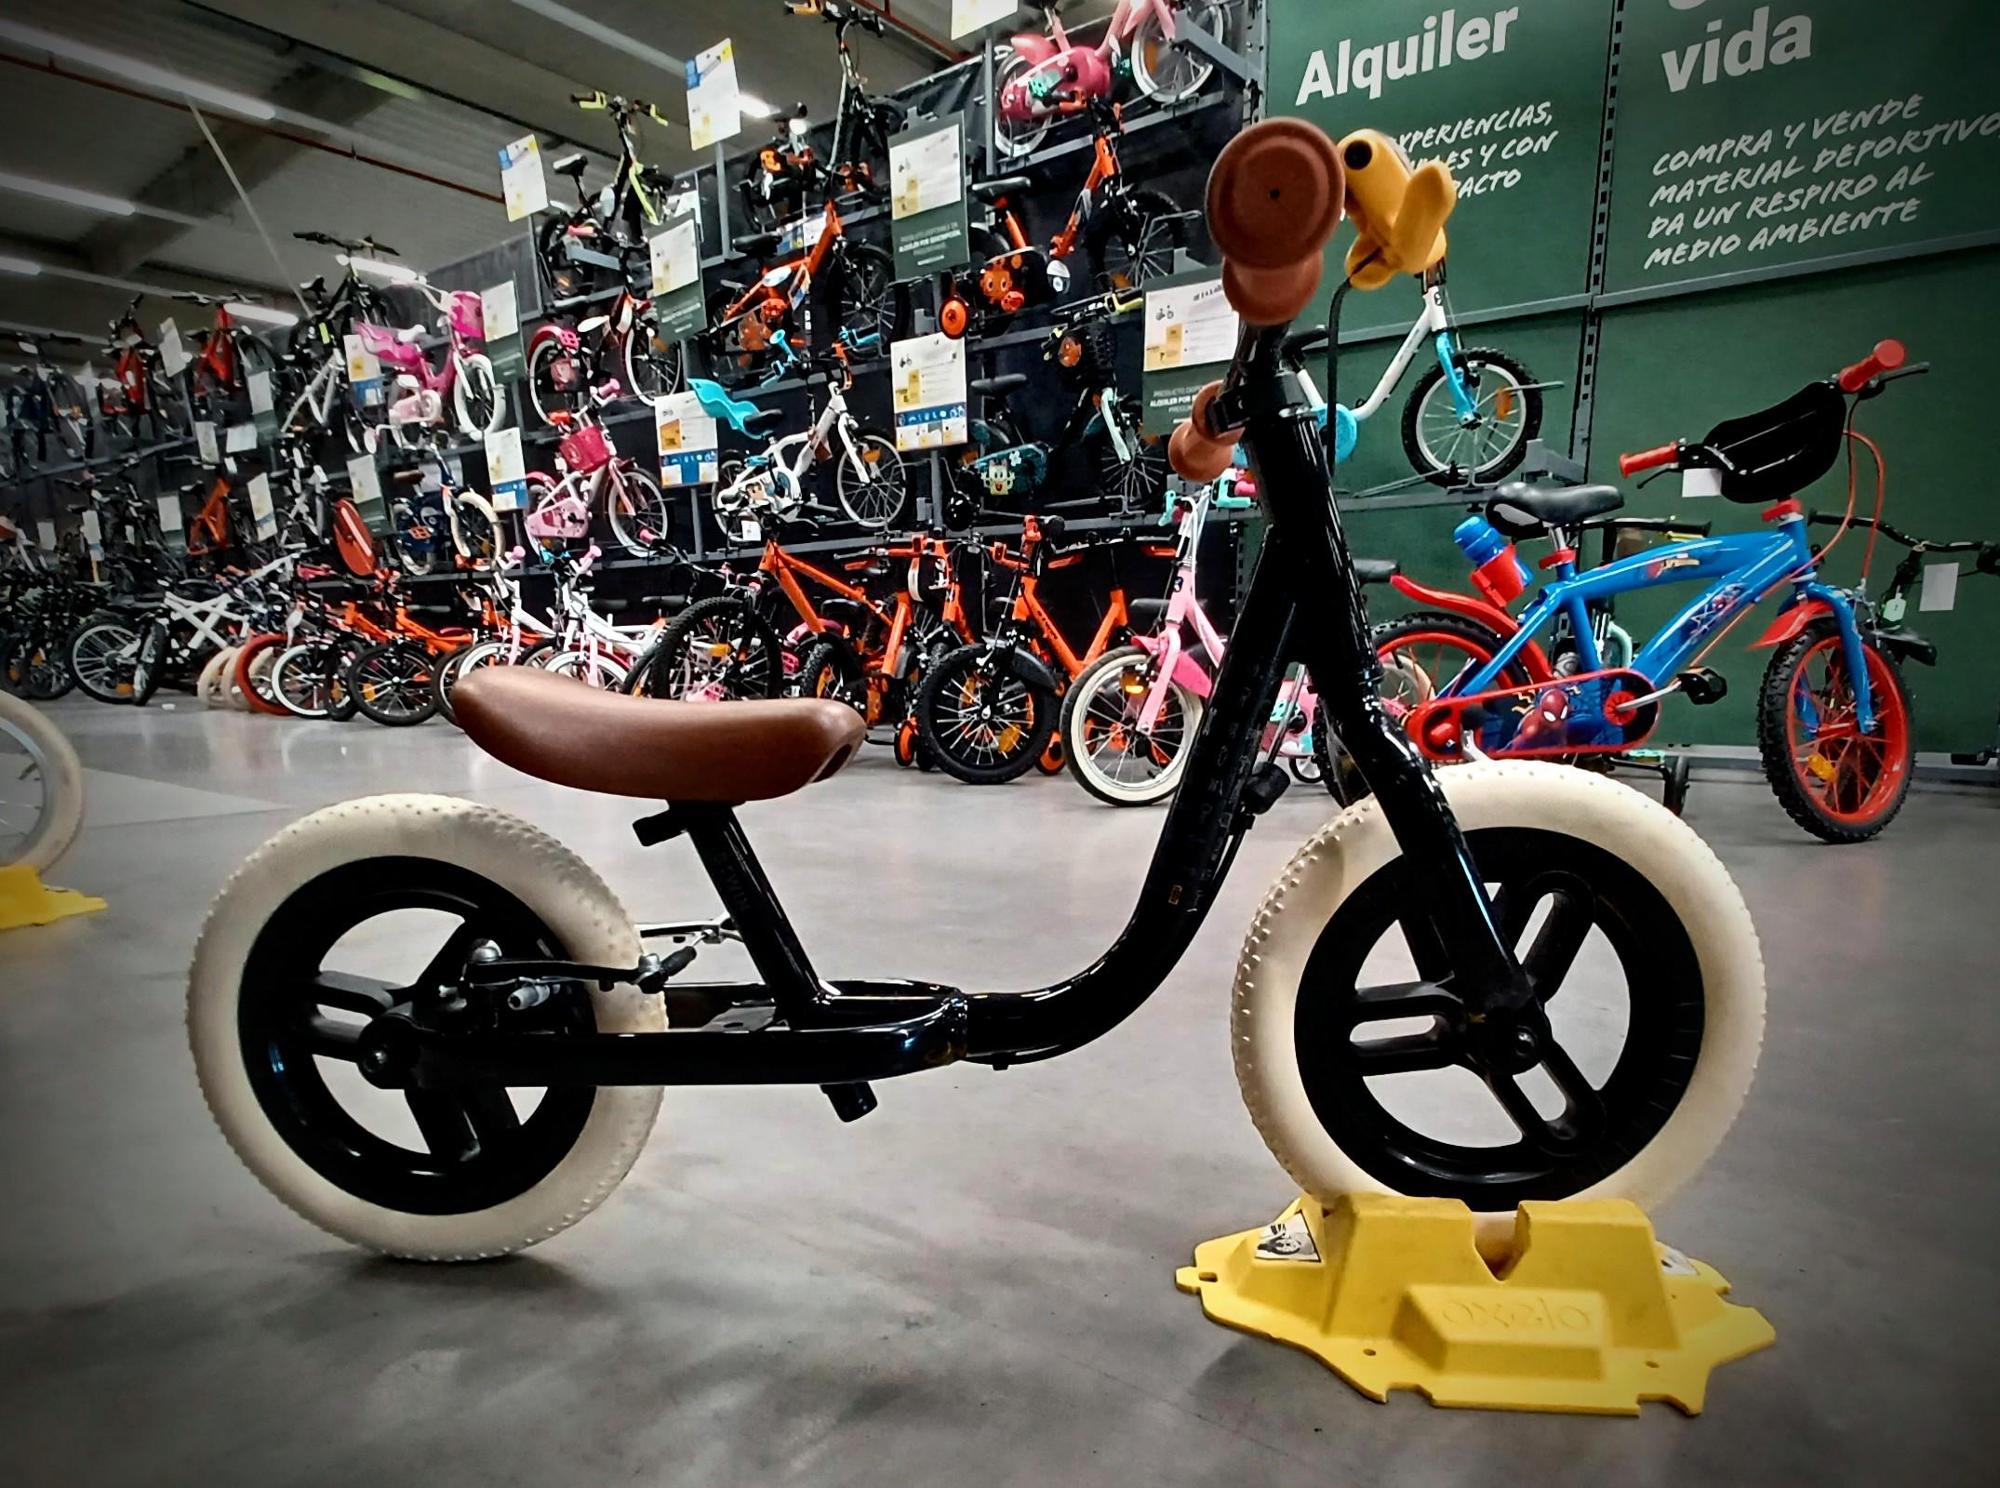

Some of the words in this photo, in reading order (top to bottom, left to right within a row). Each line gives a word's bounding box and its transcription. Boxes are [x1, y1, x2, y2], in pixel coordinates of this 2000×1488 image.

[1295, 7, 1519, 106] Alquiler
[1661, 5, 1812, 93] vida
[1393, 101, 1552, 153] XPERIENCIAS,
[1501, 130, 1559, 159] CON
[1653, 128, 1773, 176] COMPRA
[1784, 122, 1806, 149] Y
[1812, 94, 1924, 140] VENDE
[1647, 212, 1684, 238] DA
[1693, 201, 1742, 229] UN
[1746, 174, 1878, 219] RESPIRO
[1885, 161, 1934, 192] AL
[1649, 155, 1805, 207] MATERIAL
[1643, 234, 1741, 270] MEDIO
[1748, 198, 1921, 251] AMBIENTE
